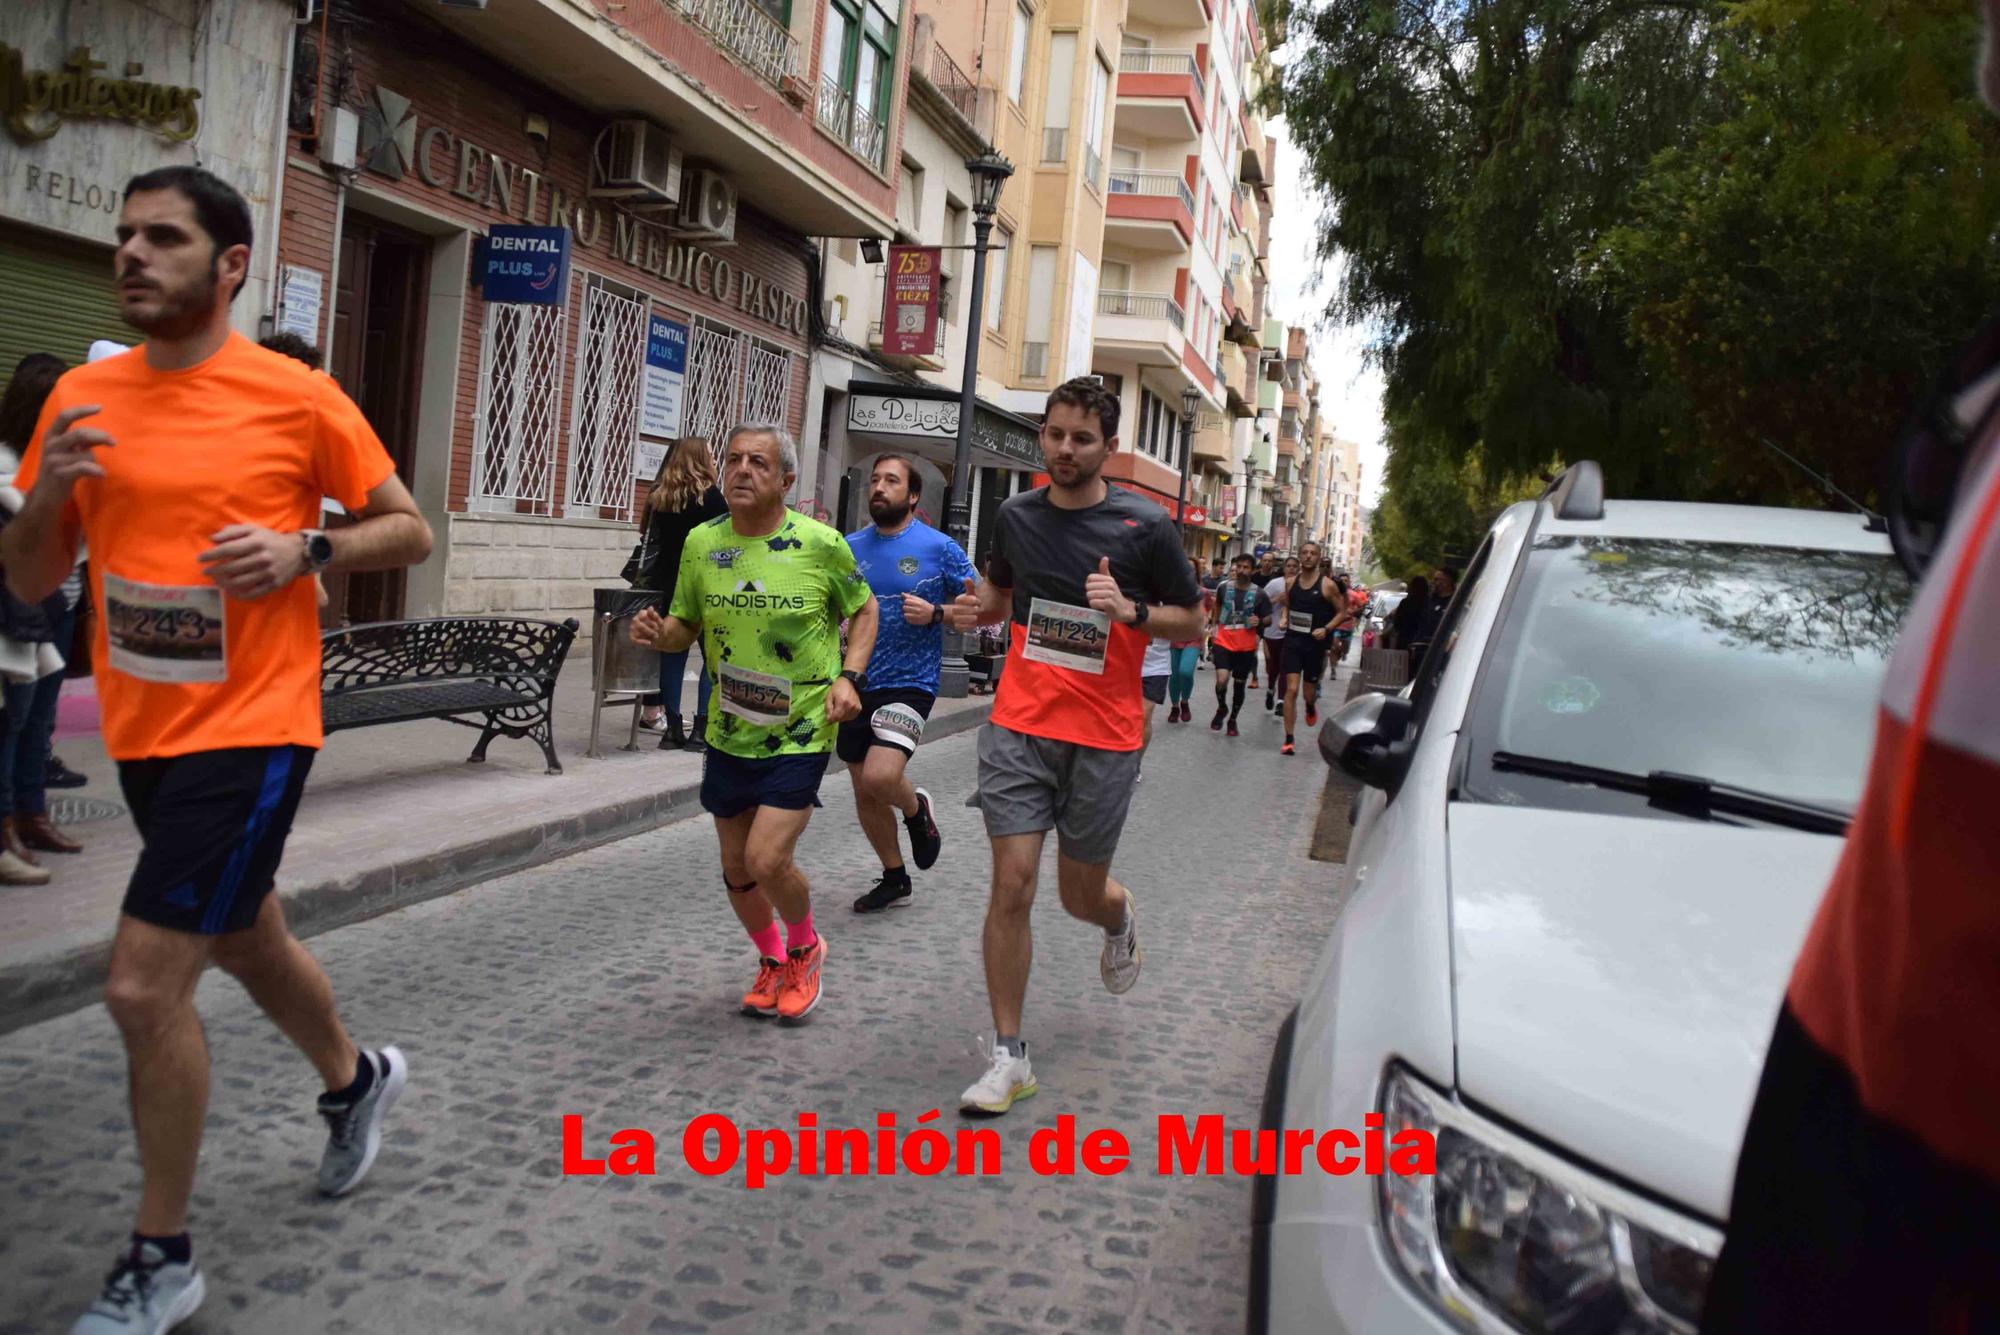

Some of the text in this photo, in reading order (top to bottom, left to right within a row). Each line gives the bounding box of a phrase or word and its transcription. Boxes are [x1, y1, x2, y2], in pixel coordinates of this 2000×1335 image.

[25, 164, 126, 214] RELOJ
[419, 125, 809, 336] CENTRO MEDICO PASEO
[491, 236, 560, 253] DENTAL
[487, 260, 533, 276] PLUS
[652, 322, 686, 345] DENTAL
[650, 342, 673, 360] PLUS
[850, 397, 960, 427] Las Delicias
[704, 594, 804, 609] FONDISTAS
[726, 609, 772, 617] YECLA
[115, 603, 207, 641] 1243
[1040, 615, 1099, 645] 1124
[727, 678, 782, 705] 1157
